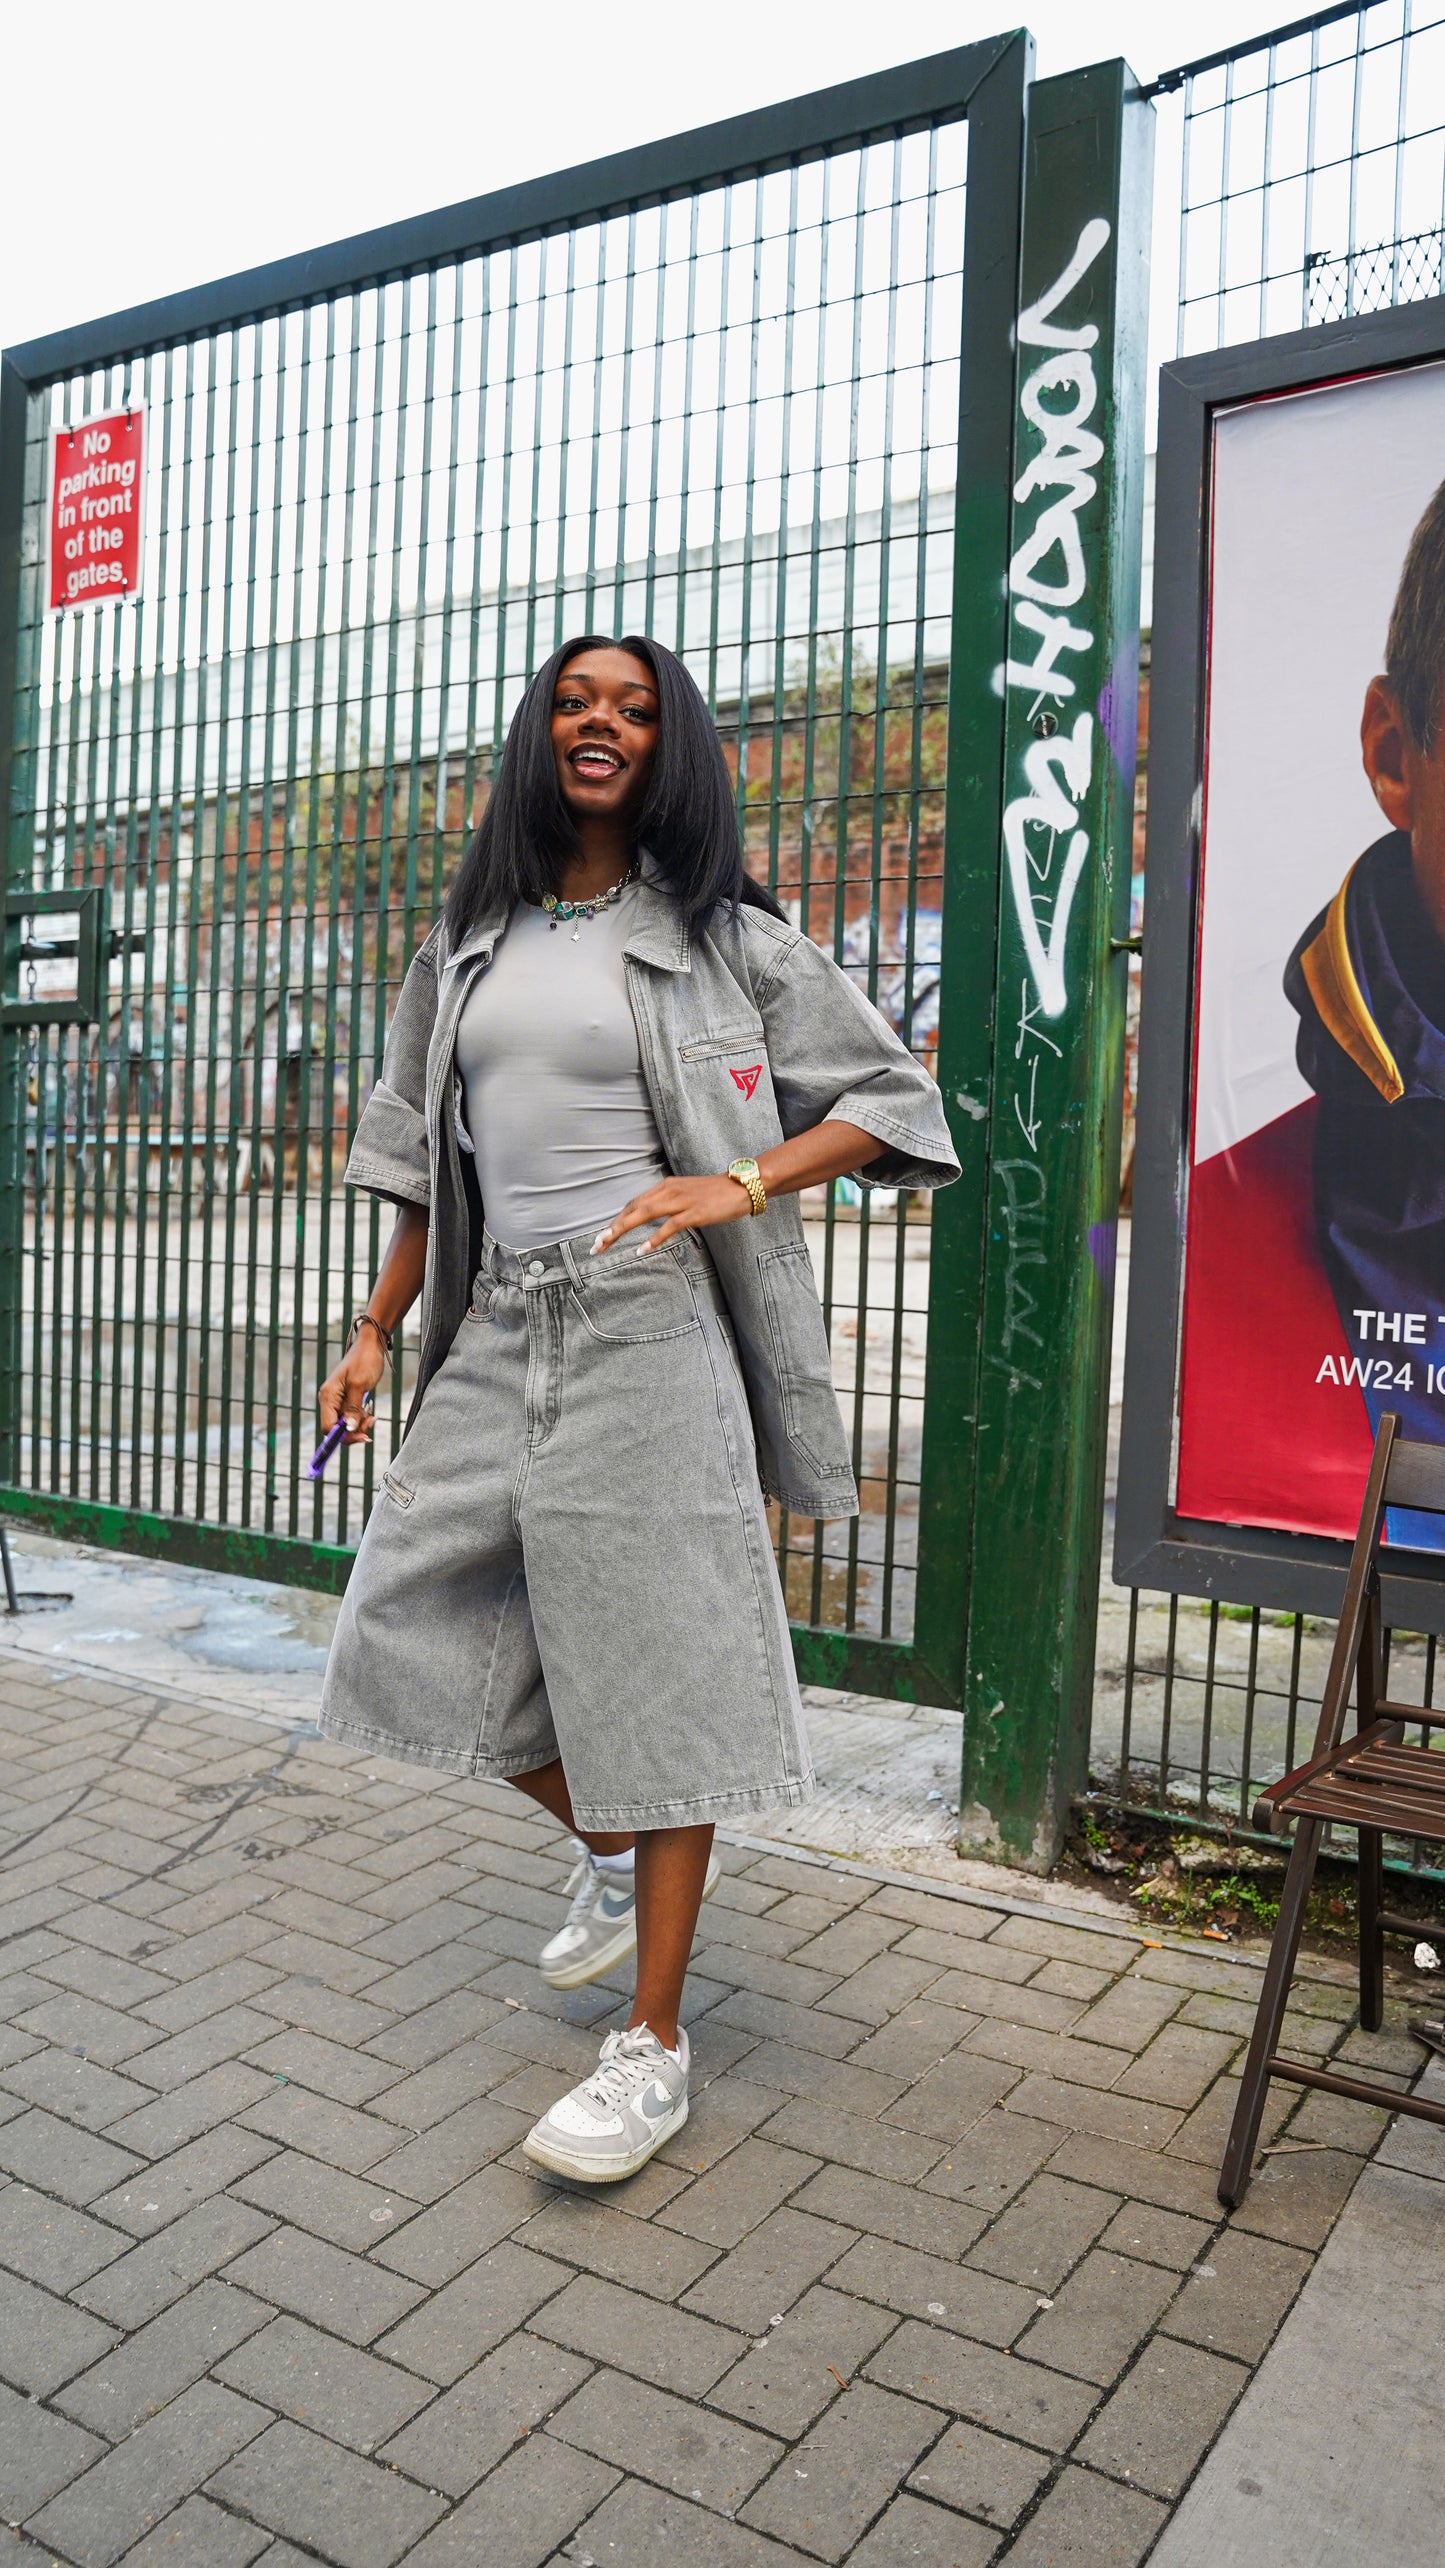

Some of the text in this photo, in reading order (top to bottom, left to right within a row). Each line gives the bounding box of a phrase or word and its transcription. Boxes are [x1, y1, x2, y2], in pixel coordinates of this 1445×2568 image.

[83, 430, 111, 458] No
[58, 459, 136, 503] parking
[58, 488, 132, 529] in front
[64, 526, 123, 559] of the
[1353, 1309, 1427, 1345] THE
[1315, 1354, 1414, 1392] AW24
